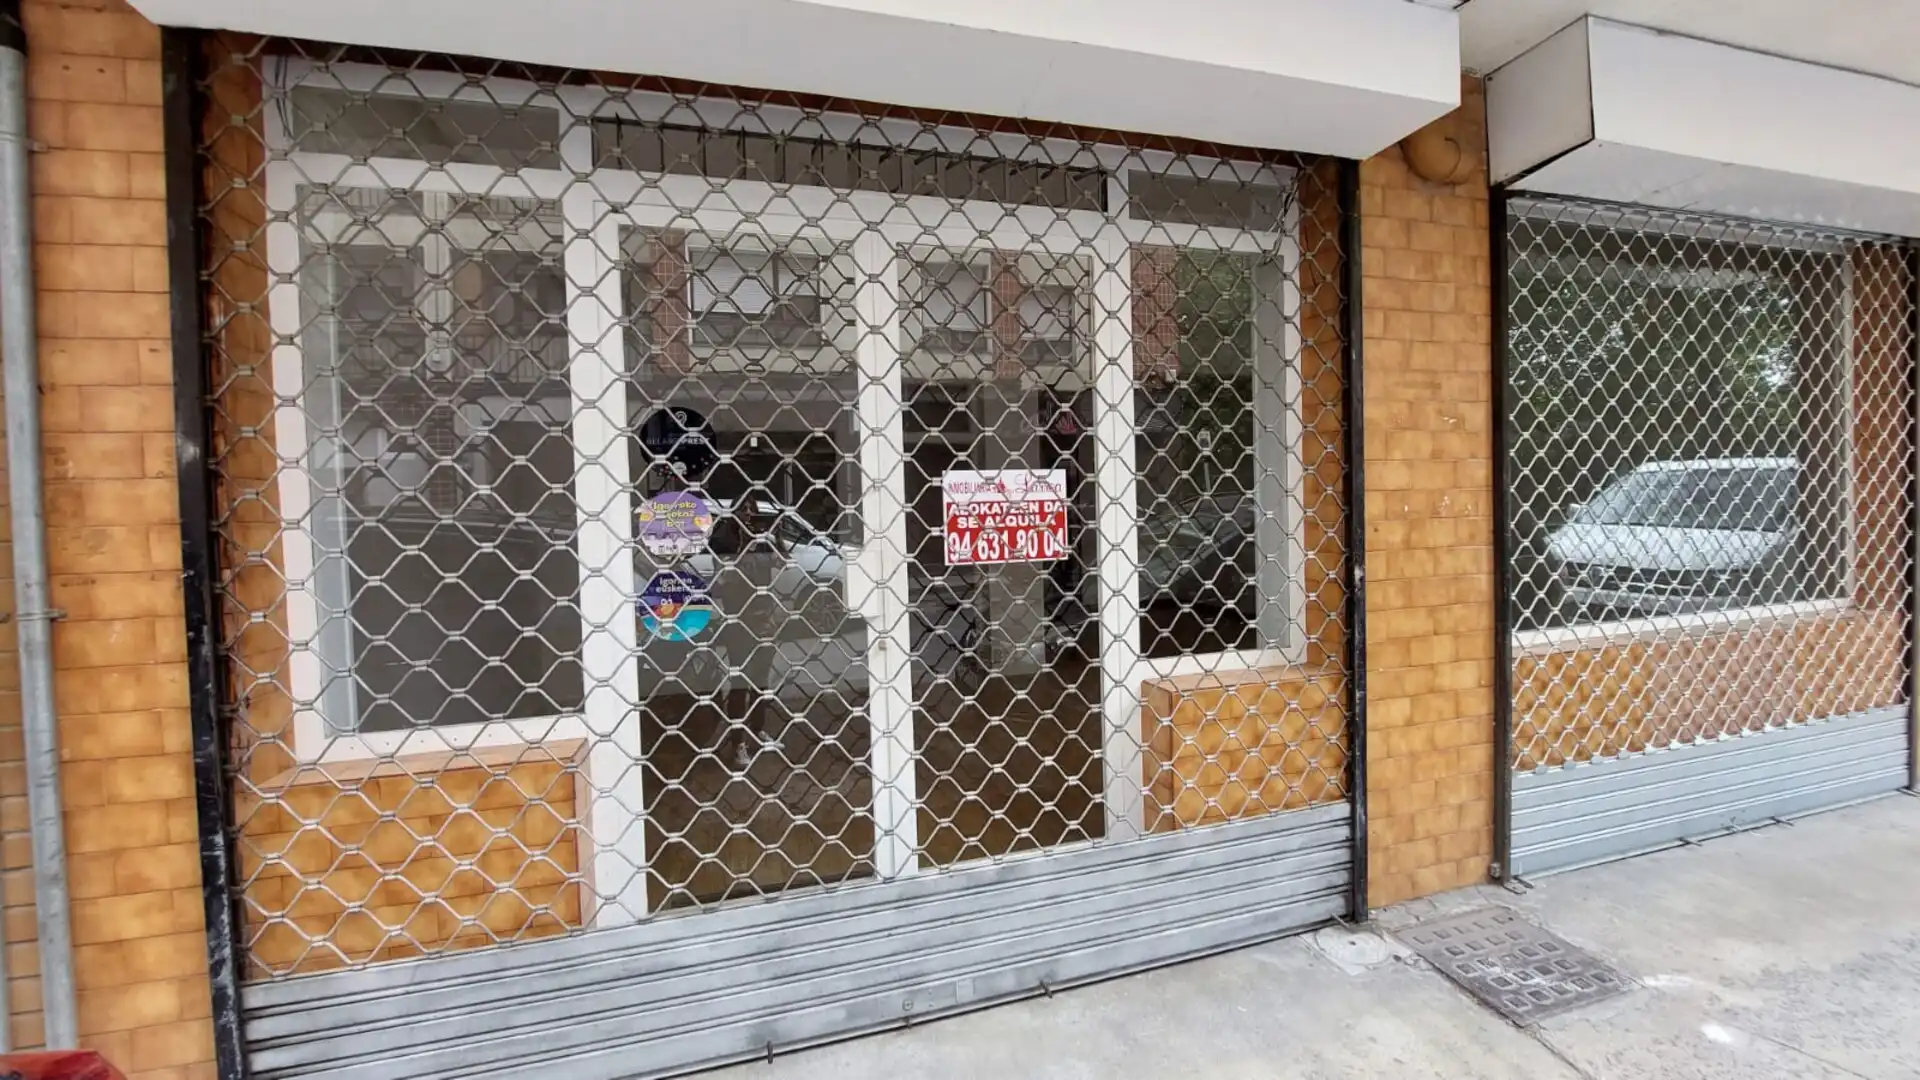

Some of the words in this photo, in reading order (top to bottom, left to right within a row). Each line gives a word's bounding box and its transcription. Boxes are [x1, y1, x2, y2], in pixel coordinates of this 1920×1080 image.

[949, 501, 1039, 516] ALOKATZEN
[1044, 501, 1063, 513] DA
[957, 517, 979, 529] SE
[984, 514, 1056, 528] ALQUILA
[949, 531, 971, 561] 94
[978, 530, 1008, 560] 631
